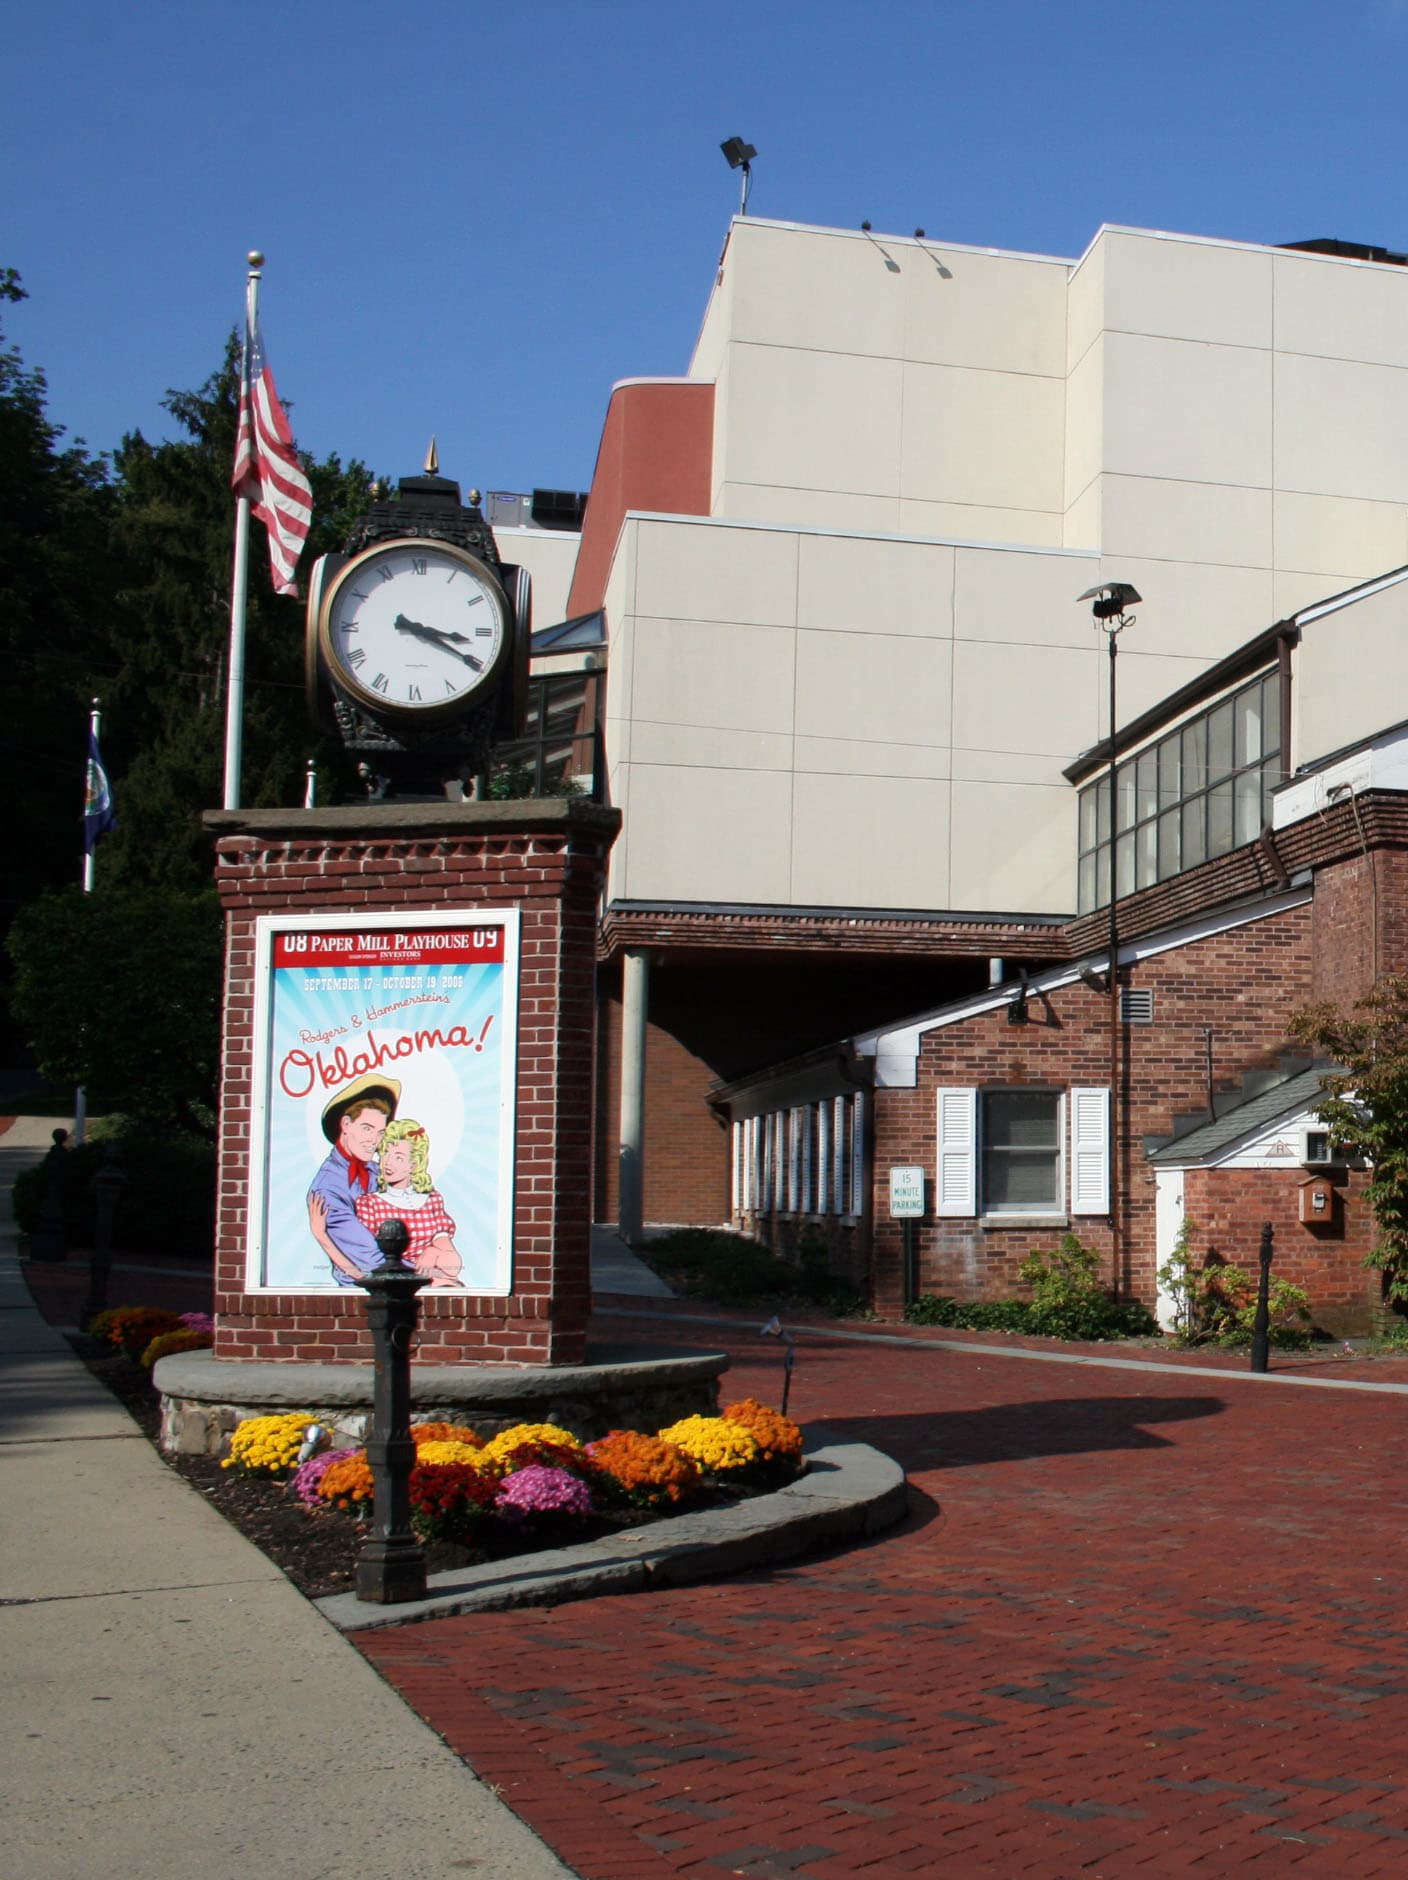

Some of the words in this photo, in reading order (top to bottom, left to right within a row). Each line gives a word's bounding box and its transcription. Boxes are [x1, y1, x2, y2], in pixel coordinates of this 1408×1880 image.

[412, 559, 427, 575] XII
[284, 932, 308, 953] 08
[311, 935, 354, 953] PAPER
[357, 934, 391, 951] MILL
[395, 933, 470, 950] PLAYHOUSE
[304, 978, 360, 991] SEPTEMBER
[363, 978, 373, 990] 17
[383, 976, 423, 990] OCTOBER
[300, 1025, 348, 1044] Rodgers
[351, 1015, 363, 1028] &
[279, 1015, 494, 1097] Oklahoma!
[902, 1174, 911, 1183] 15
[894, 1187, 919, 1196] MINUTE
[893, 1200, 922, 1209] PARKING
